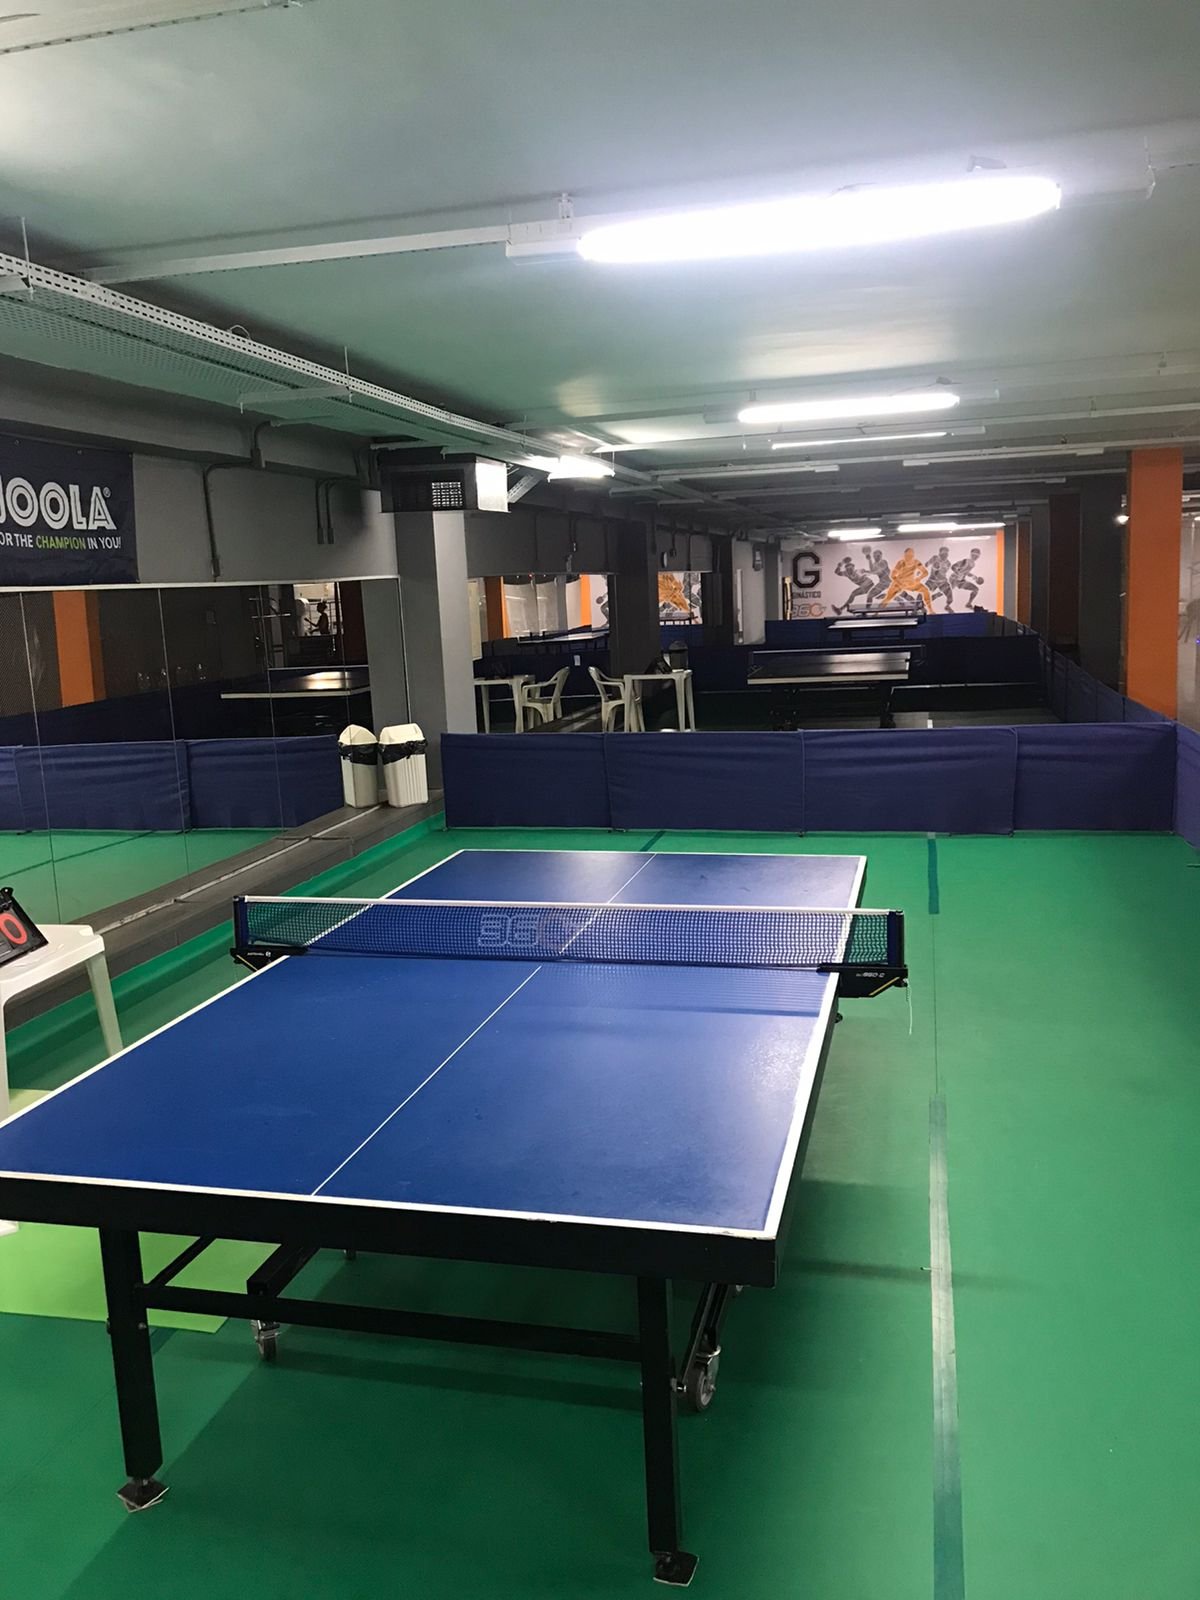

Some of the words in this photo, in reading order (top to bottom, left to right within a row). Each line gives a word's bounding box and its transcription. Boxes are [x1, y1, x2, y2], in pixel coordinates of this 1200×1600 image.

[0, 531, 13, 546] OR
[14, 533, 33, 548] THE
[36, 535, 86, 550] CHAMPION
[87, 537, 98, 550] IN
[99, 536, 121, 550] YOU!
[793, 552, 820, 588] G
[0, 912, 28, 945] 0
